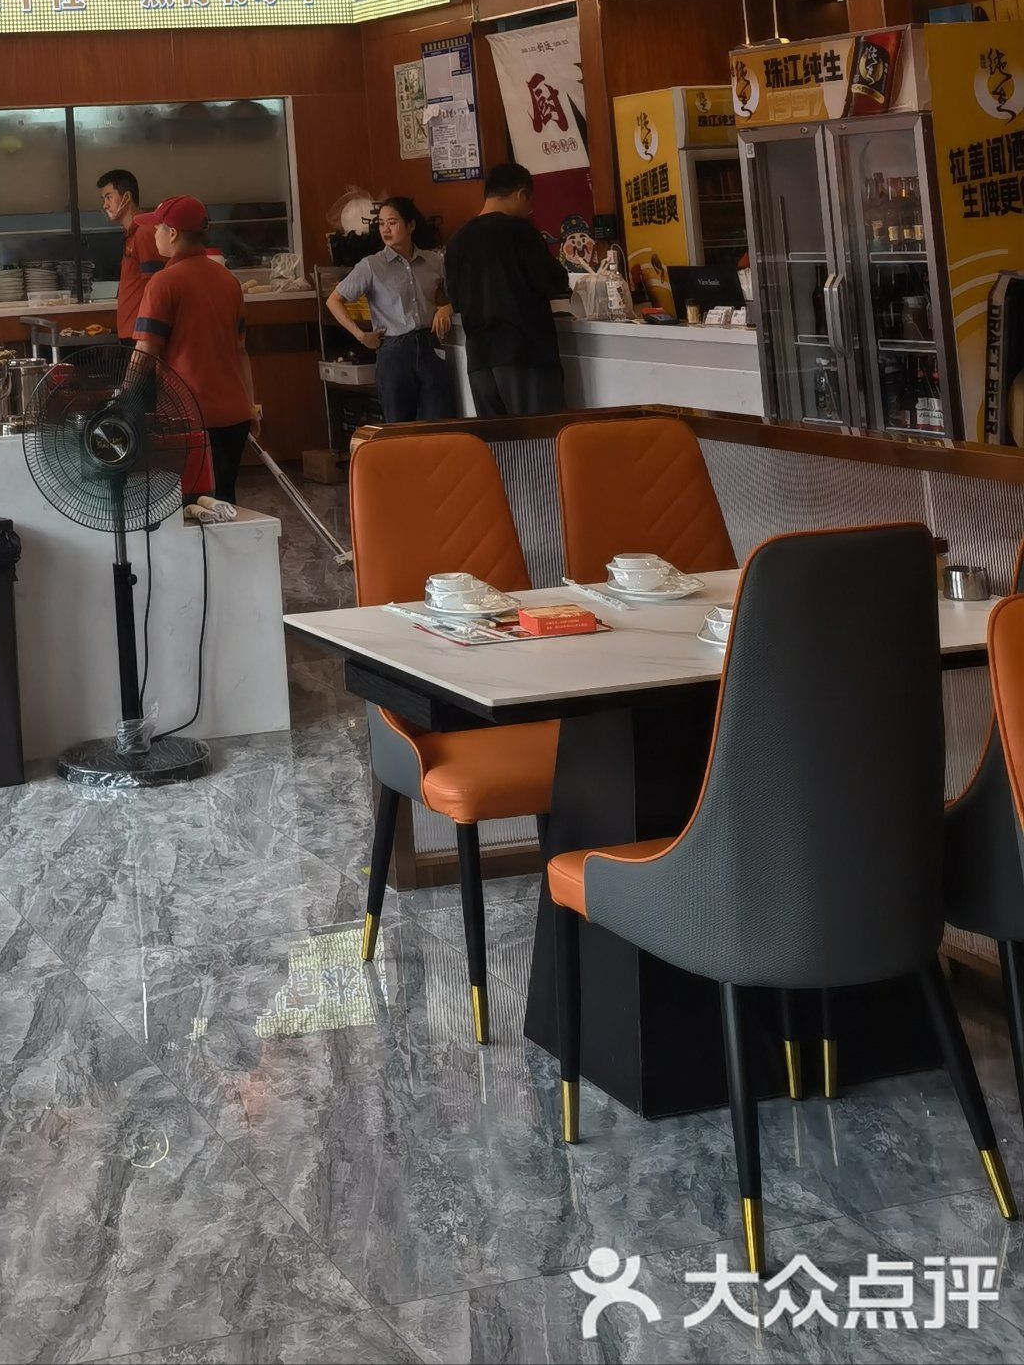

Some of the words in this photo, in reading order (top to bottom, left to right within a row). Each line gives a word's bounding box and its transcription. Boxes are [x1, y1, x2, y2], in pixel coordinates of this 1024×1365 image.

[763, 49, 844, 89] 珠江纯生
[625, 163, 670, 204] 拉盖闻酒香
[962, 175, 1024, 219] 生啤更
